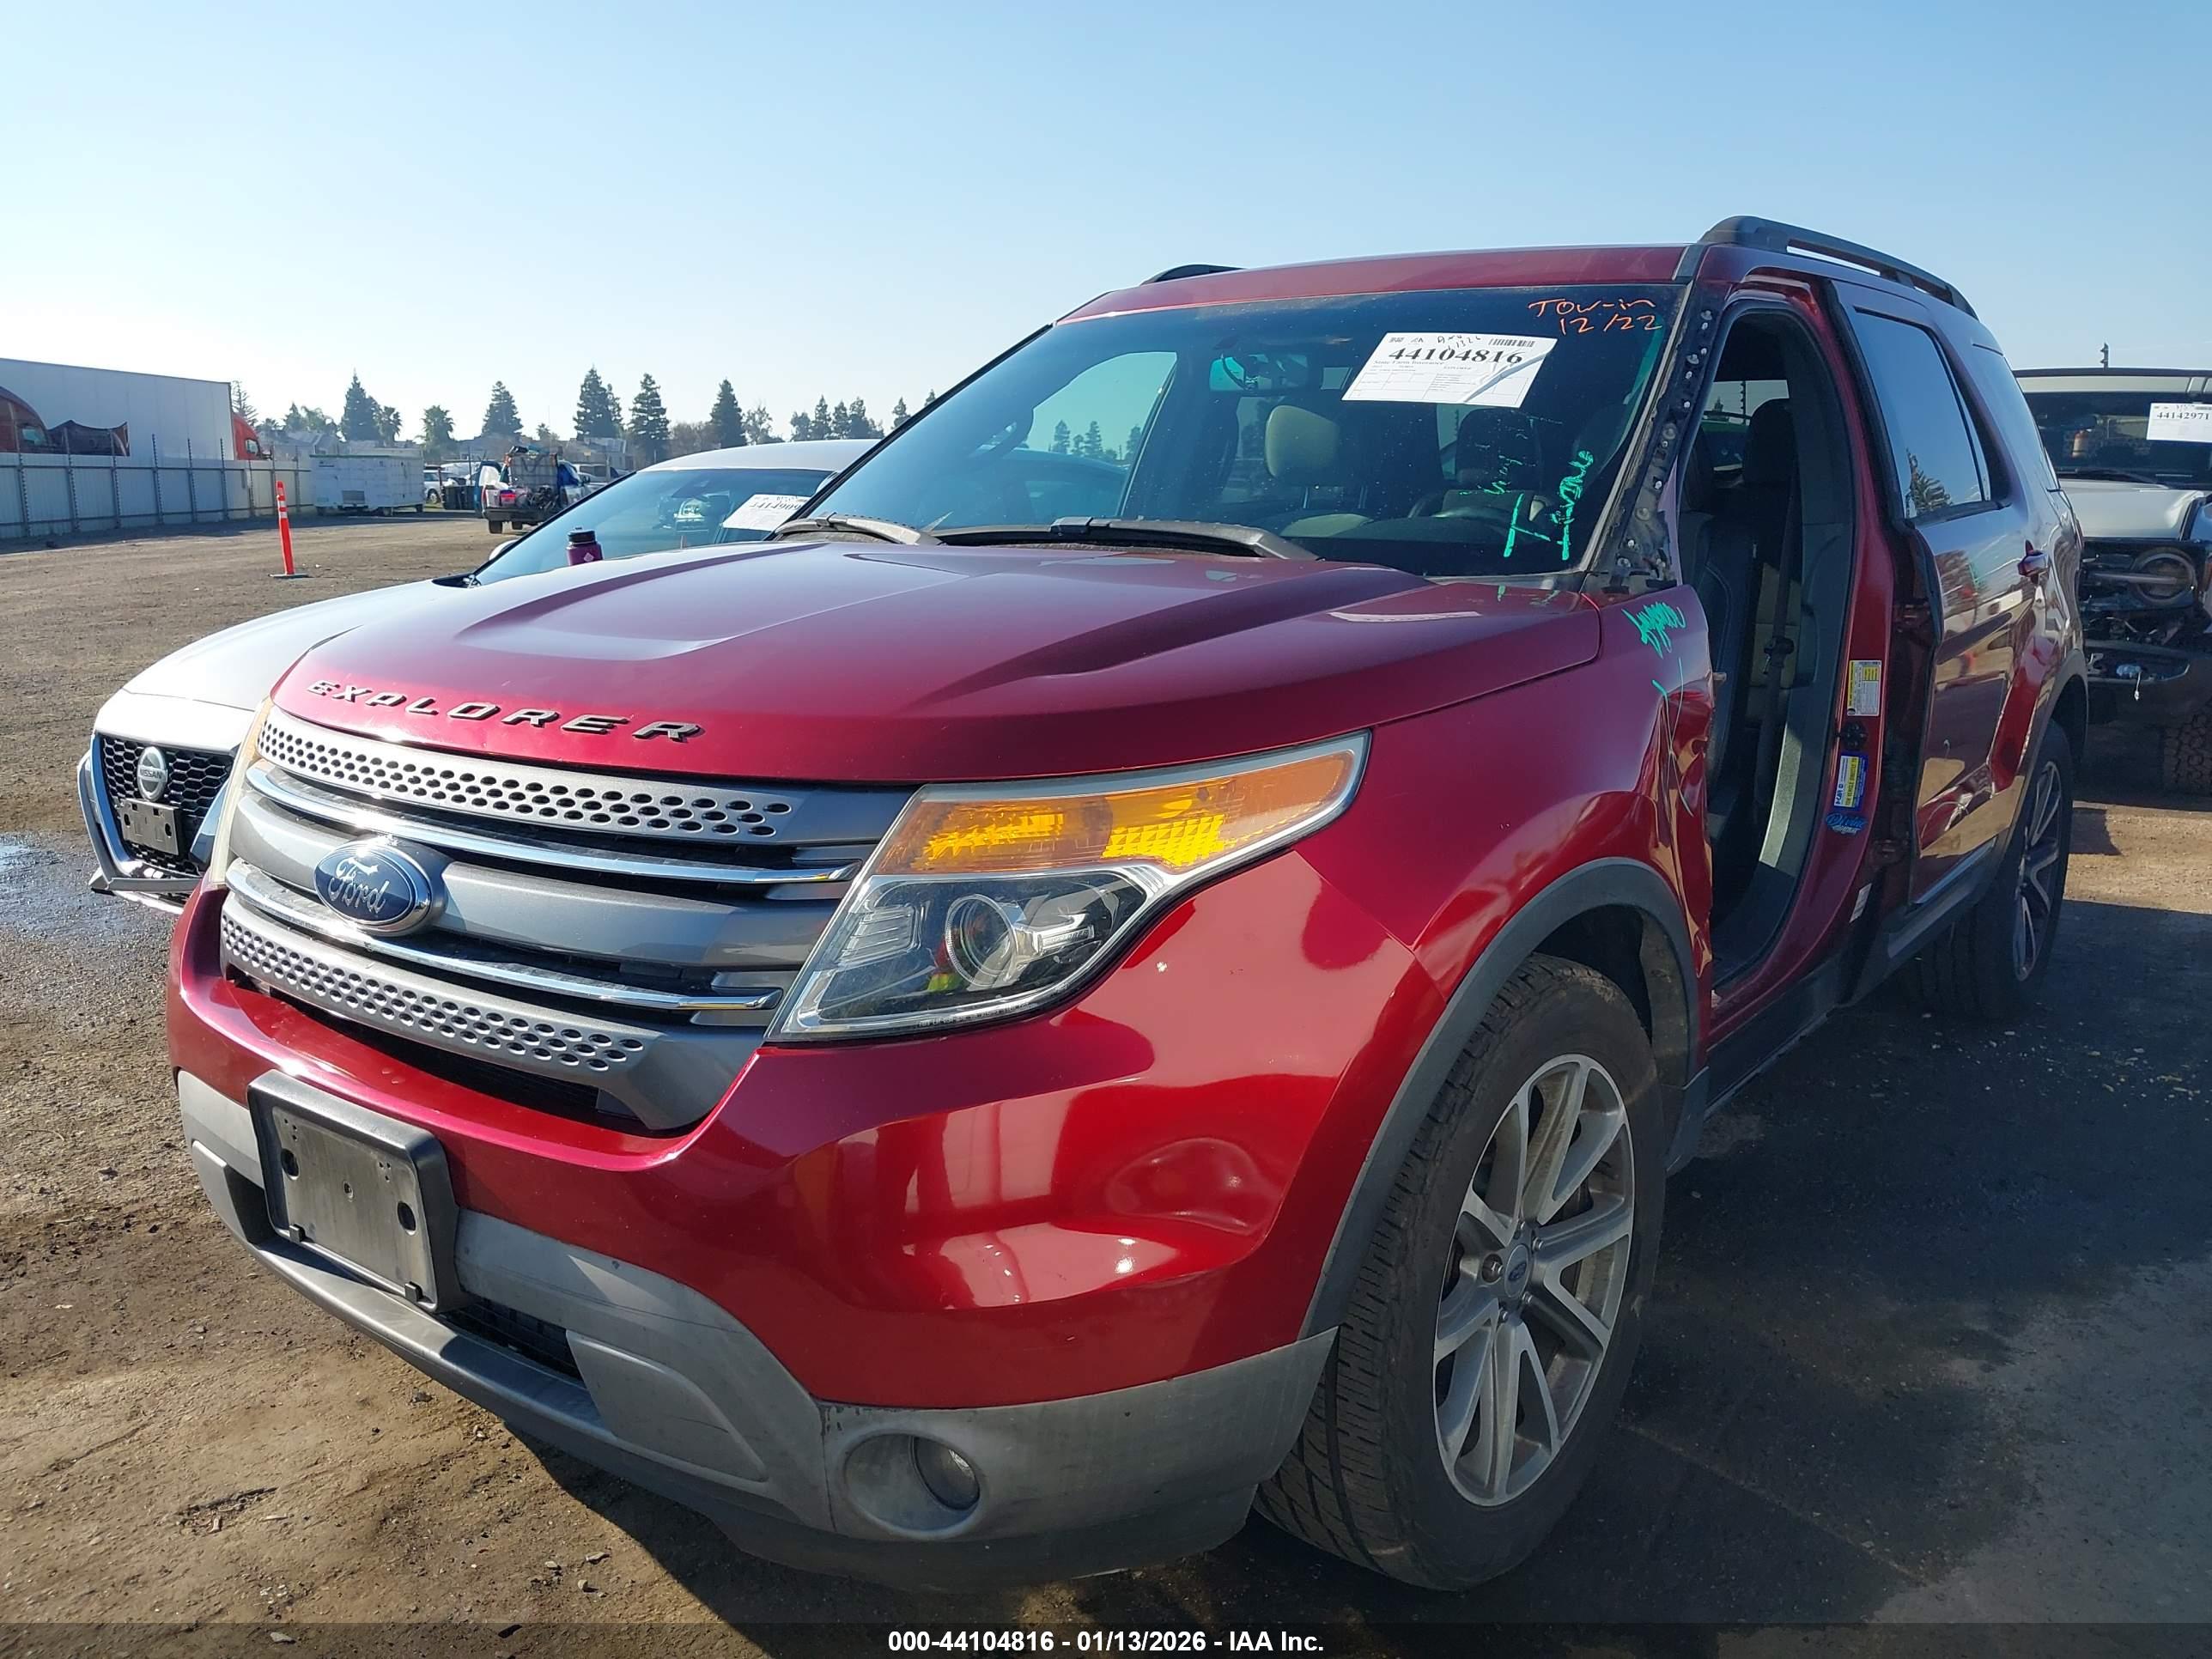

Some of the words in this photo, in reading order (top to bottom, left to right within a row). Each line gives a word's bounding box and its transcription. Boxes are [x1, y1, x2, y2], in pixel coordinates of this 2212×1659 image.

[1389, 347, 1525, 364] 44104816
[307, 679, 706, 744] EXPLORER
[139, 767, 162, 780] NISSAN
[326, 856, 390, 915] Ford
